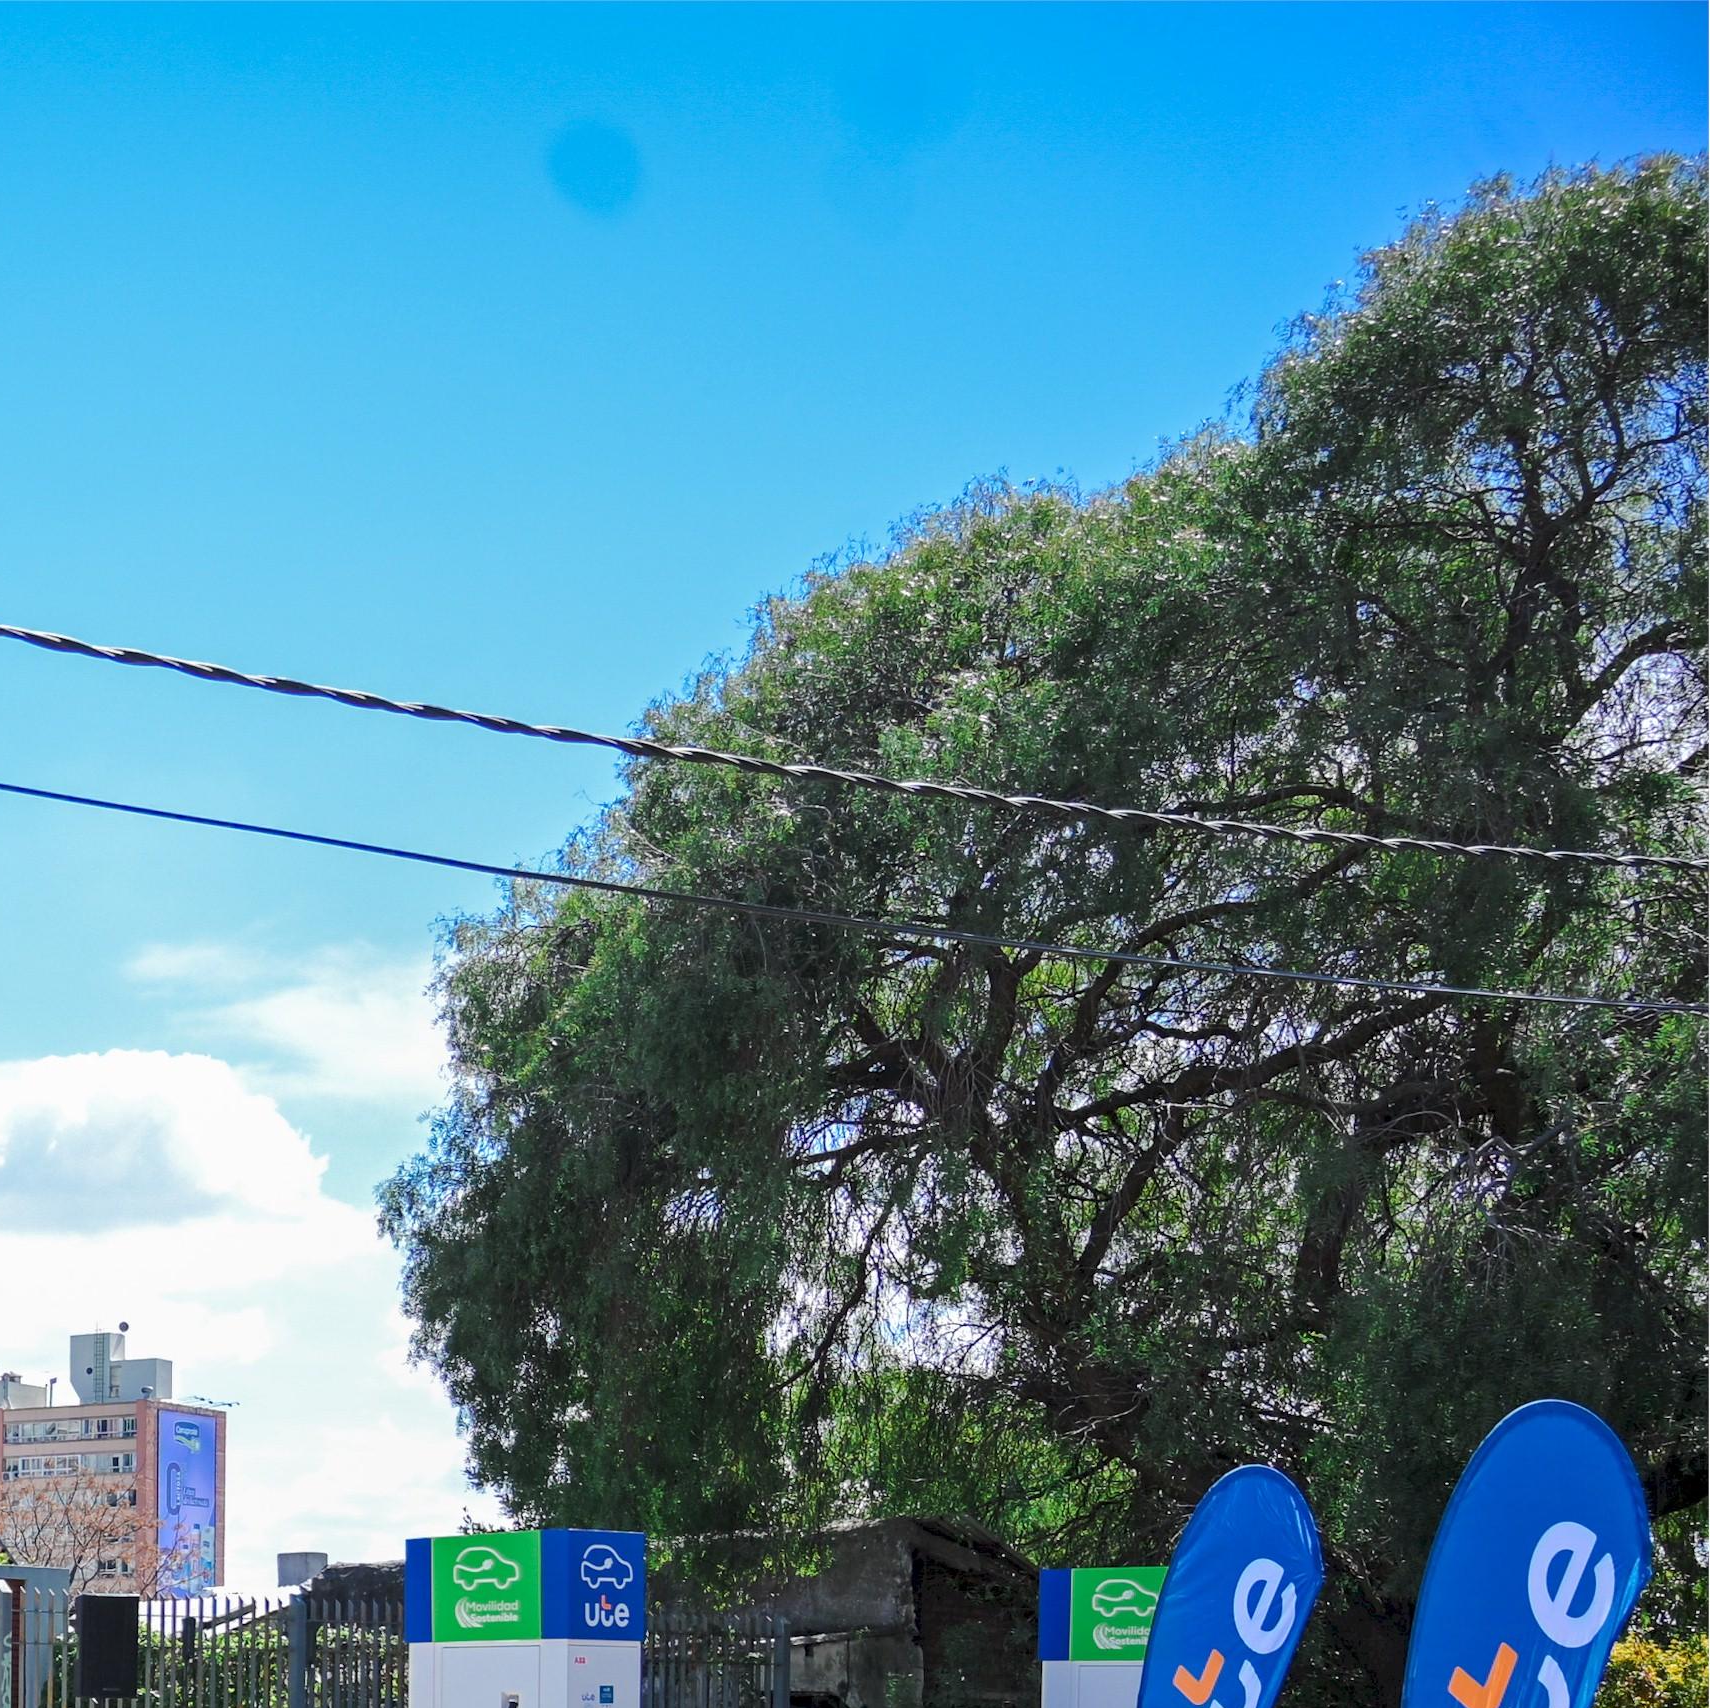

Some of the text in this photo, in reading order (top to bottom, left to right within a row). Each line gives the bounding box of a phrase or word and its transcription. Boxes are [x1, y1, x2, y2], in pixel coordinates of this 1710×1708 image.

[466, 1600, 519, 1612] Movilidad
[585, 1594, 630, 1627] ute
[469, 1611, 519, 1622] Sostenible
[1106, 1625, 1151, 1636] Movilida
